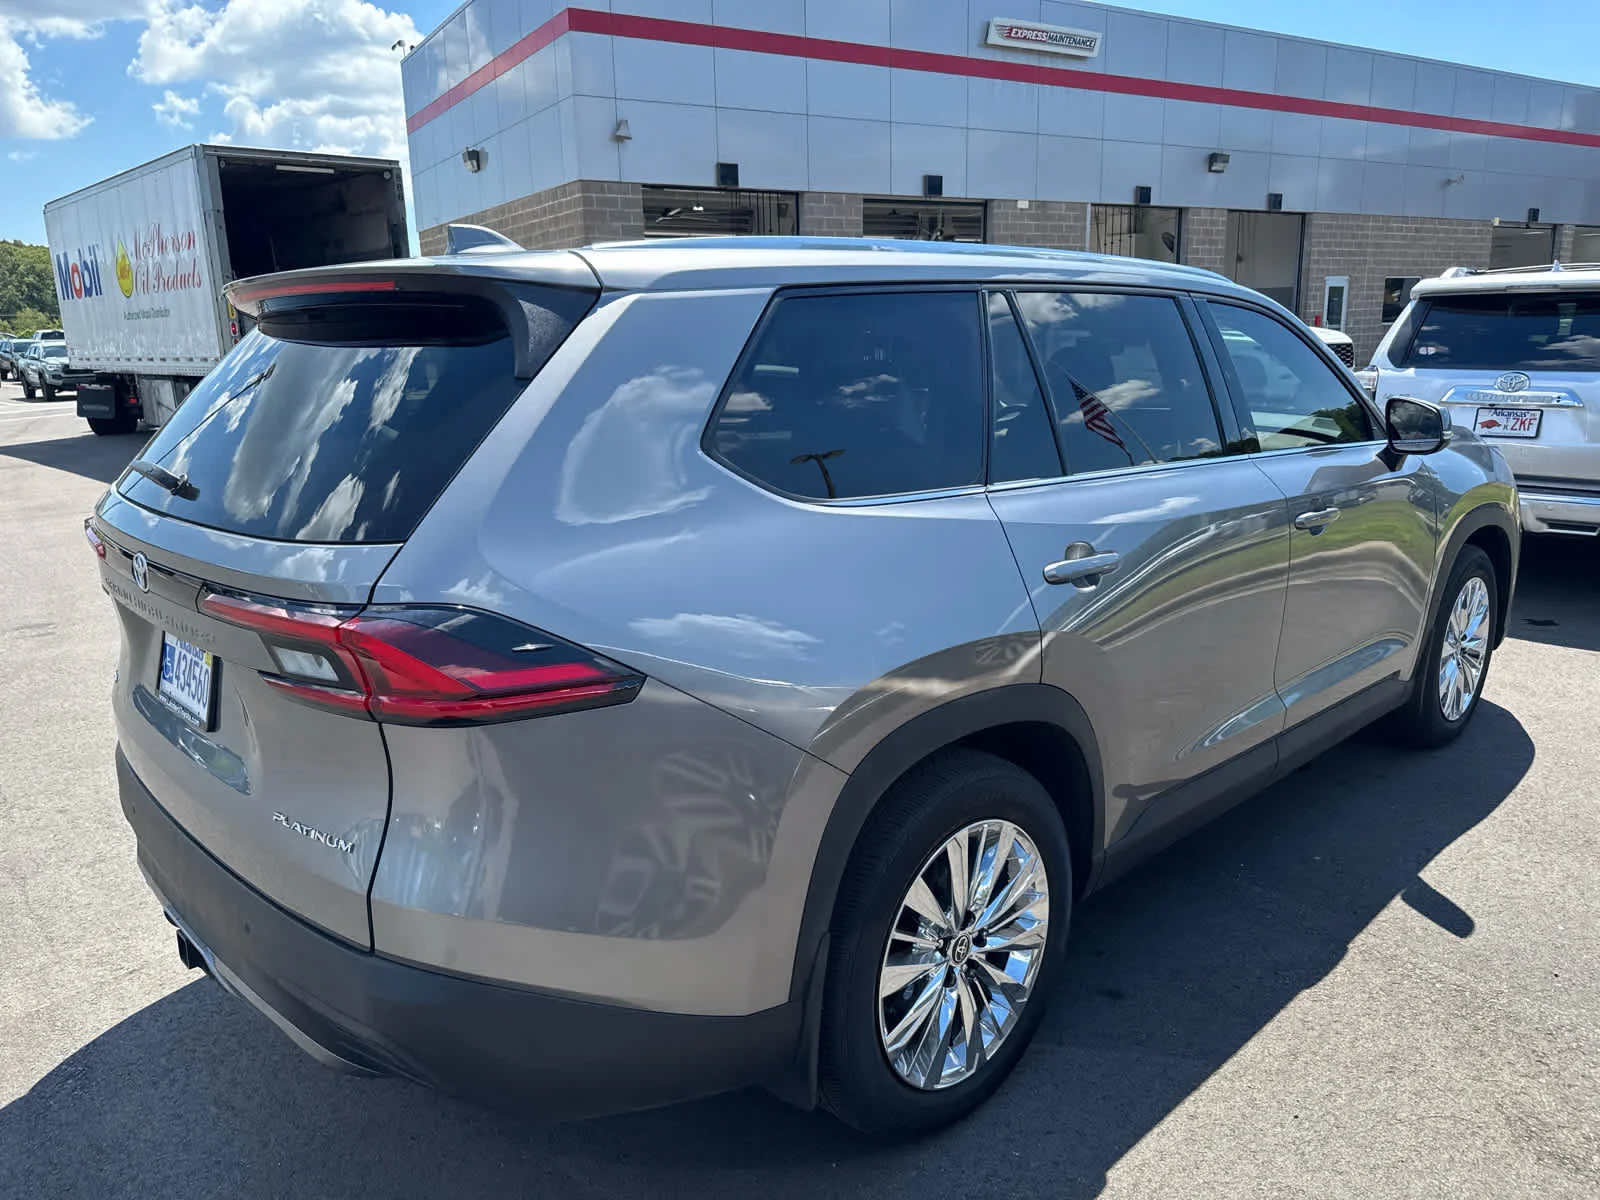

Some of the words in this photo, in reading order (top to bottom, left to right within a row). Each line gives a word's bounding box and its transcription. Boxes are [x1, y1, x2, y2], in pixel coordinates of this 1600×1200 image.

[1010, 28, 1048, 41] EXPRESS
[56, 243, 103, 301] Mobil
[152, 255, 202, 294] Products
[174, 648, 210, 709] 434560
[272, 810, 355, 854] PLATINUM
